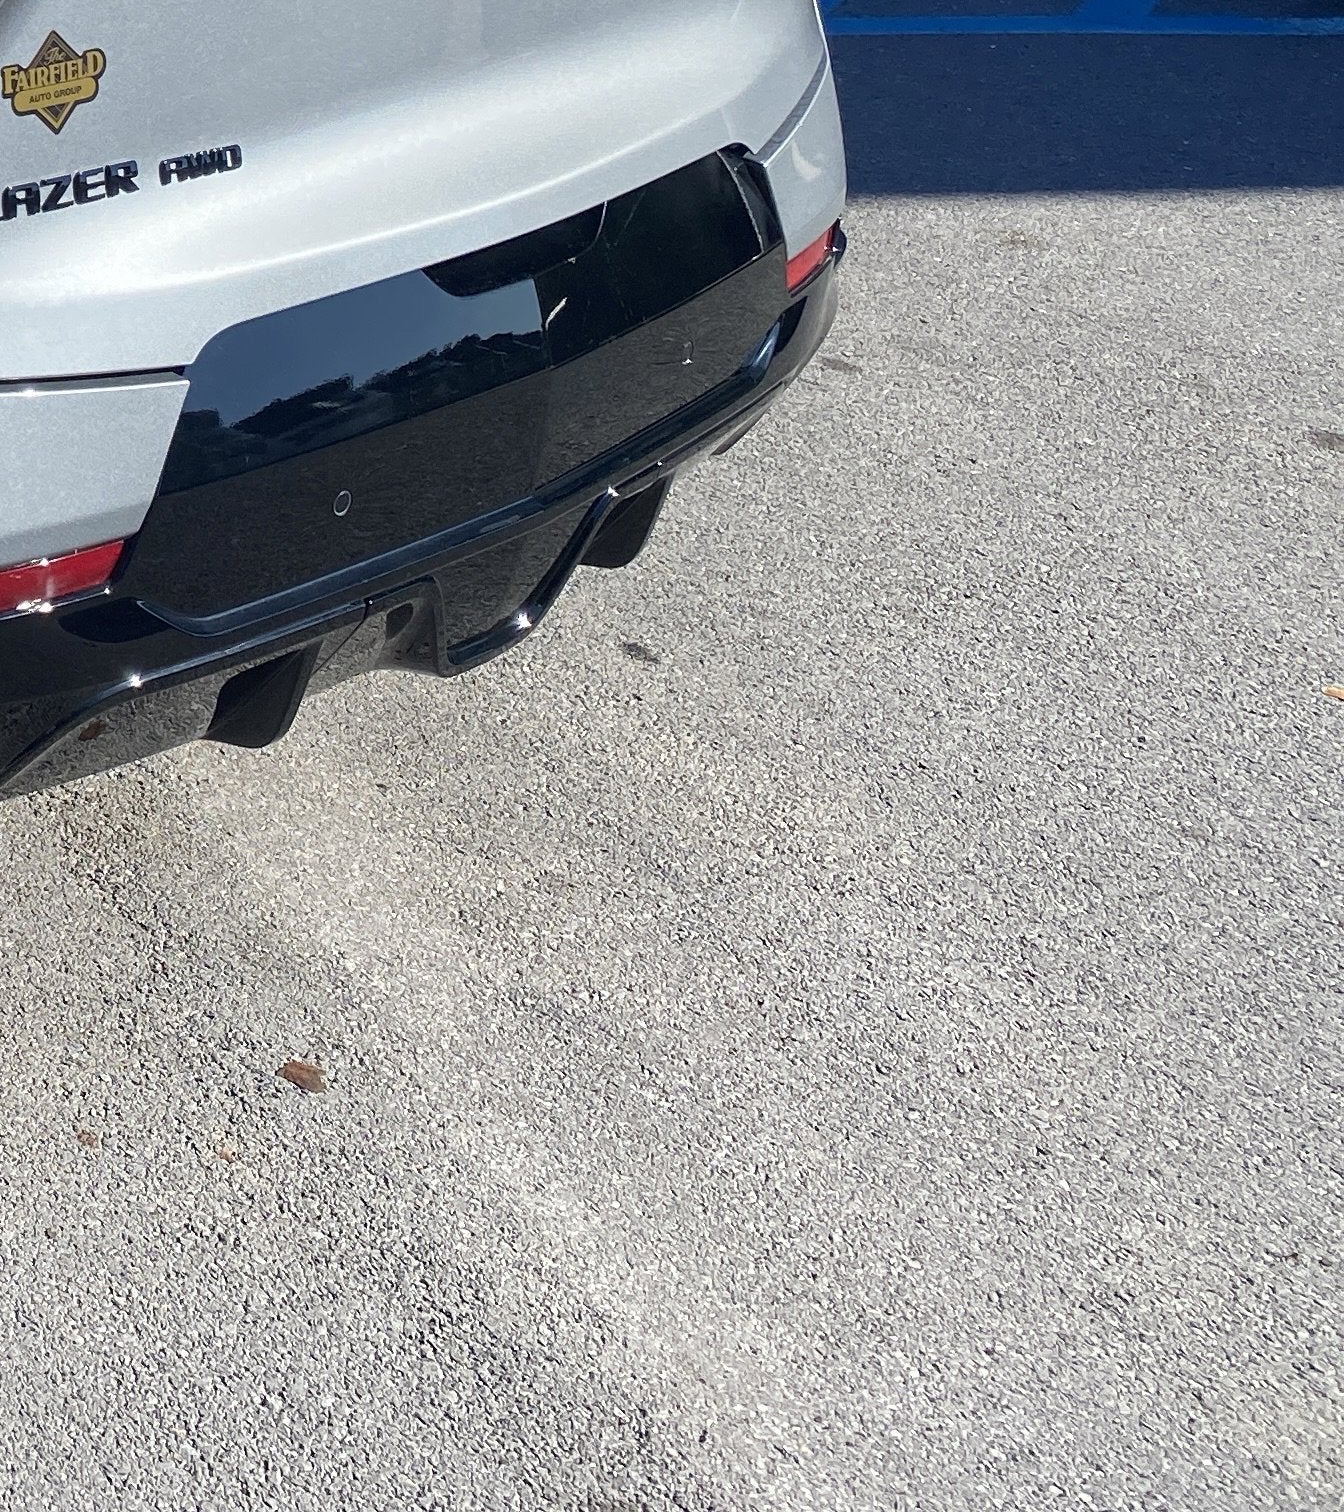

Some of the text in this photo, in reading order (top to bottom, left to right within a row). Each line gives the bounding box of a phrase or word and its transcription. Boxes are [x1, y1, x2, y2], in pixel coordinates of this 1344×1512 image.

[2, 50, 105, 95] FAIRFIELD
[29, 86, 82, 104] AUTO GROUP
[159, 144, 243, 186] AWD
